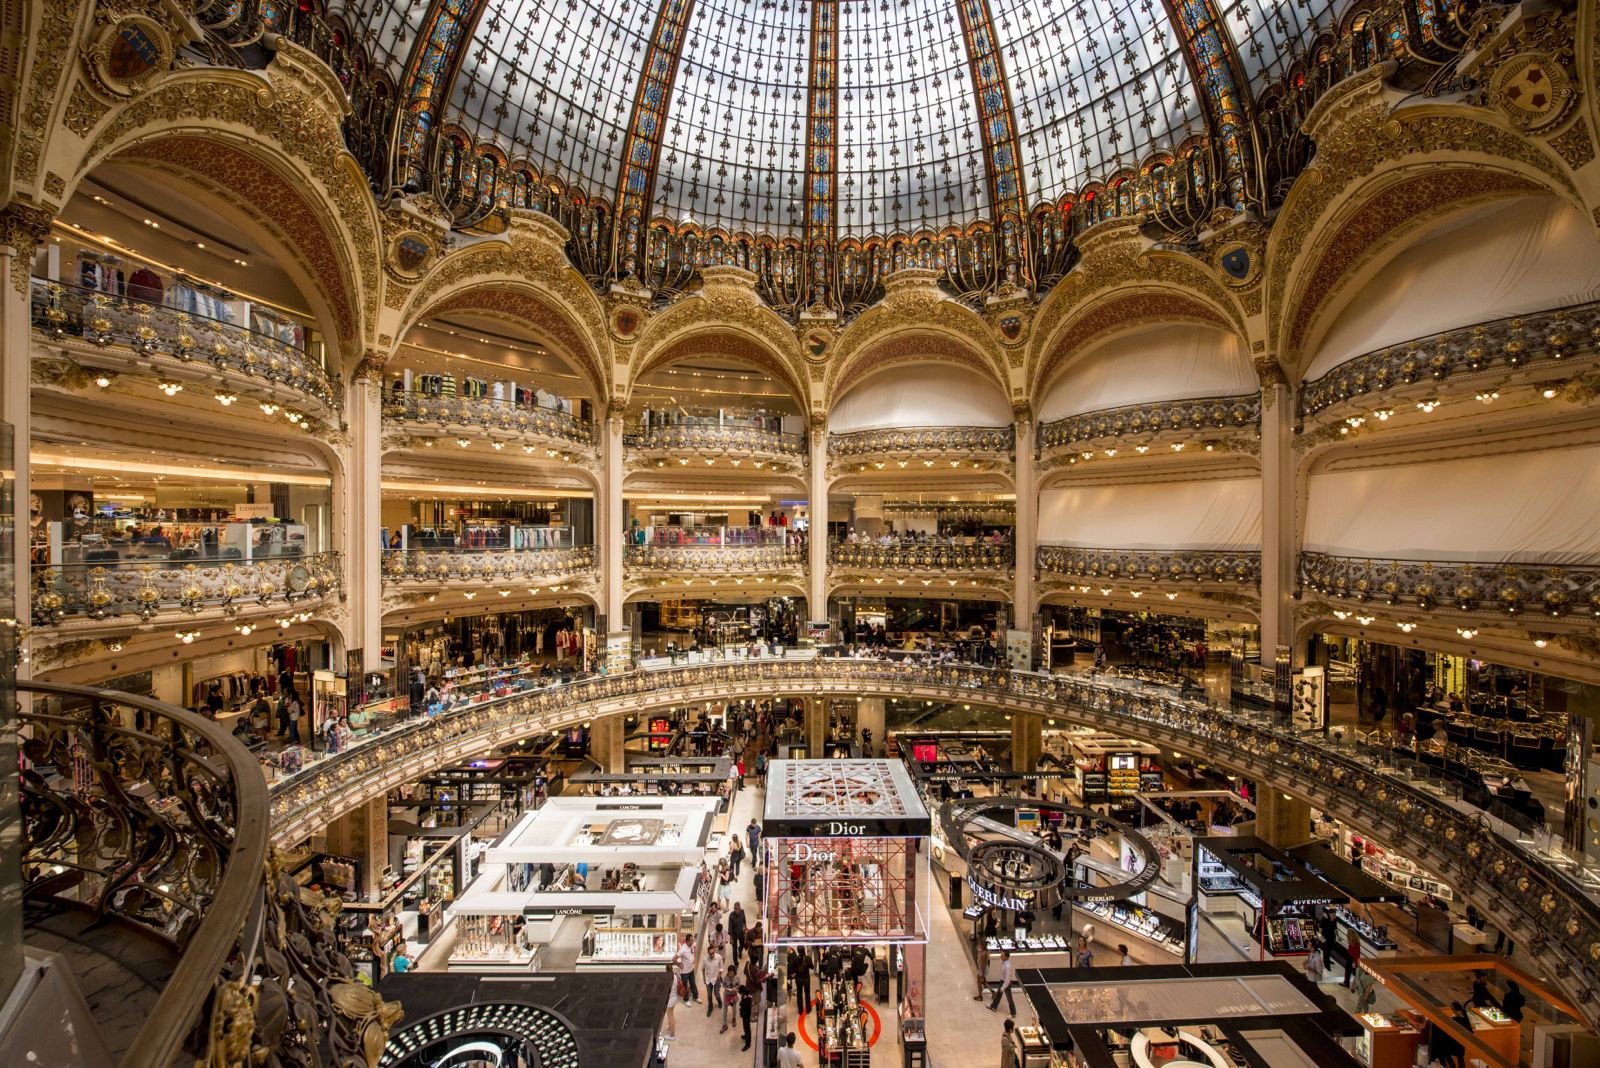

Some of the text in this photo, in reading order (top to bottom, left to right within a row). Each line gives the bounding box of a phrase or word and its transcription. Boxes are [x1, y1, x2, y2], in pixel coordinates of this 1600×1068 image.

[829, 822, 866, 835] Dior
[792, 843, 837, 862] Dior
[968, 875, 1026, 910] GUERLAIN
[1088, 894, 1114, 902] GUERLAIN
